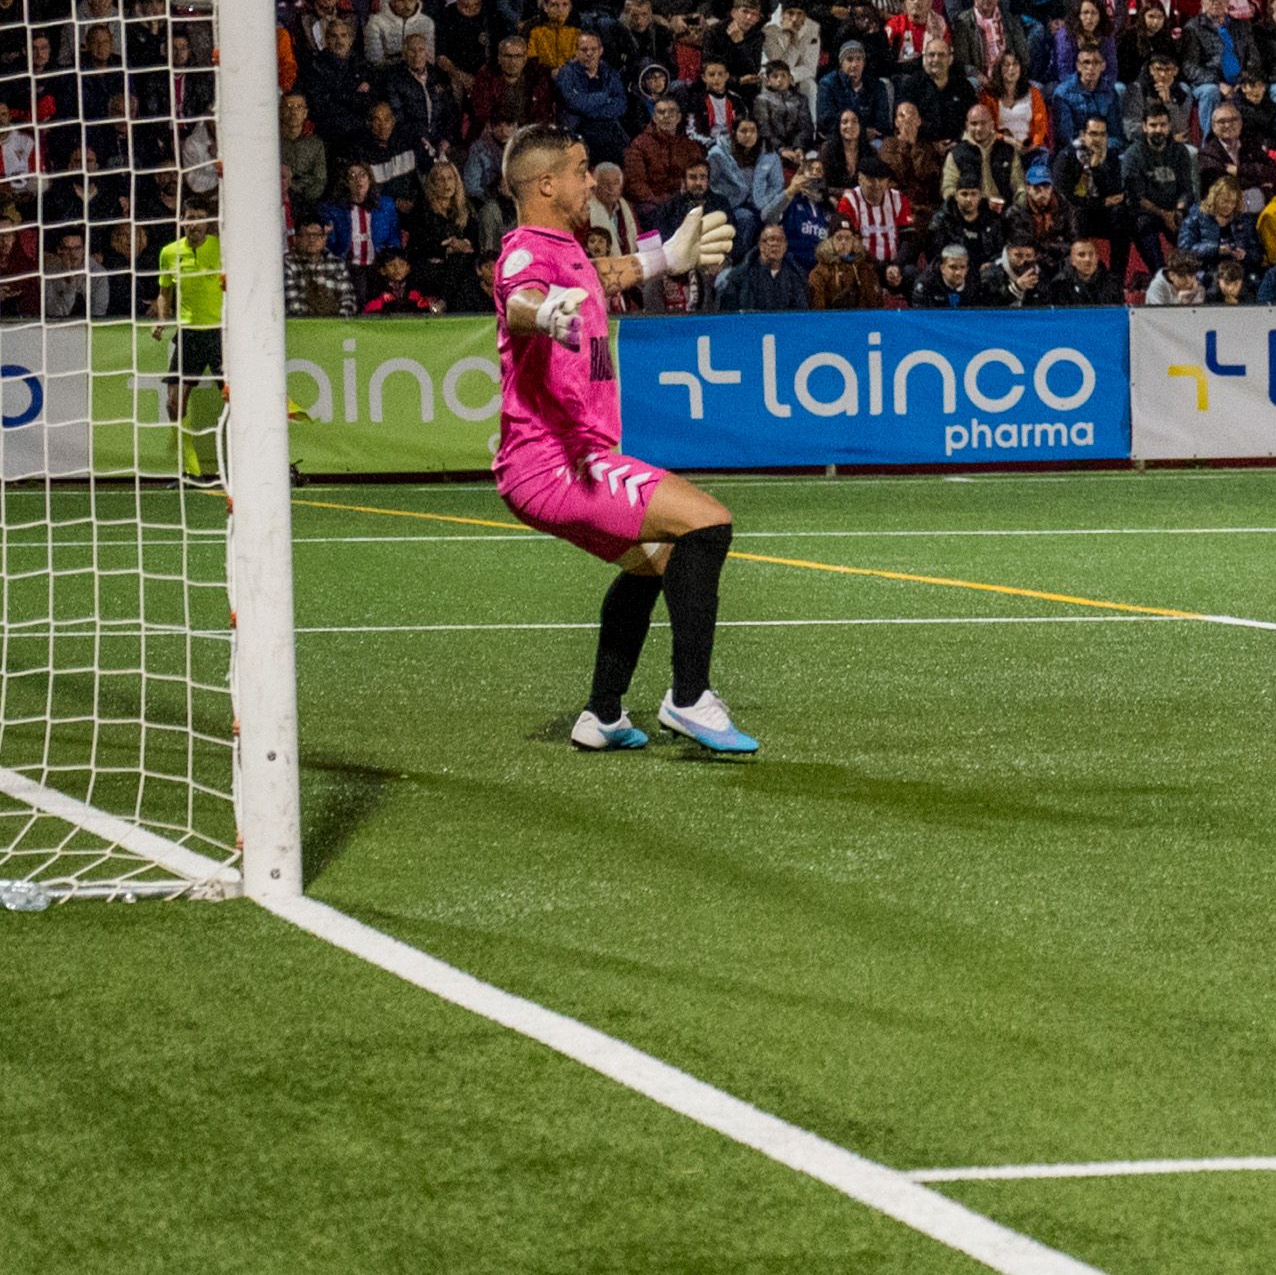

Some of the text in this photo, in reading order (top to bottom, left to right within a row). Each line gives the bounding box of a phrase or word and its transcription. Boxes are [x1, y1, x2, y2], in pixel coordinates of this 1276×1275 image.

[286, 338, 503, 423] ainc
[762, 331, 1096, 418] lainco
[945, 418, 1095, 456] pharma
